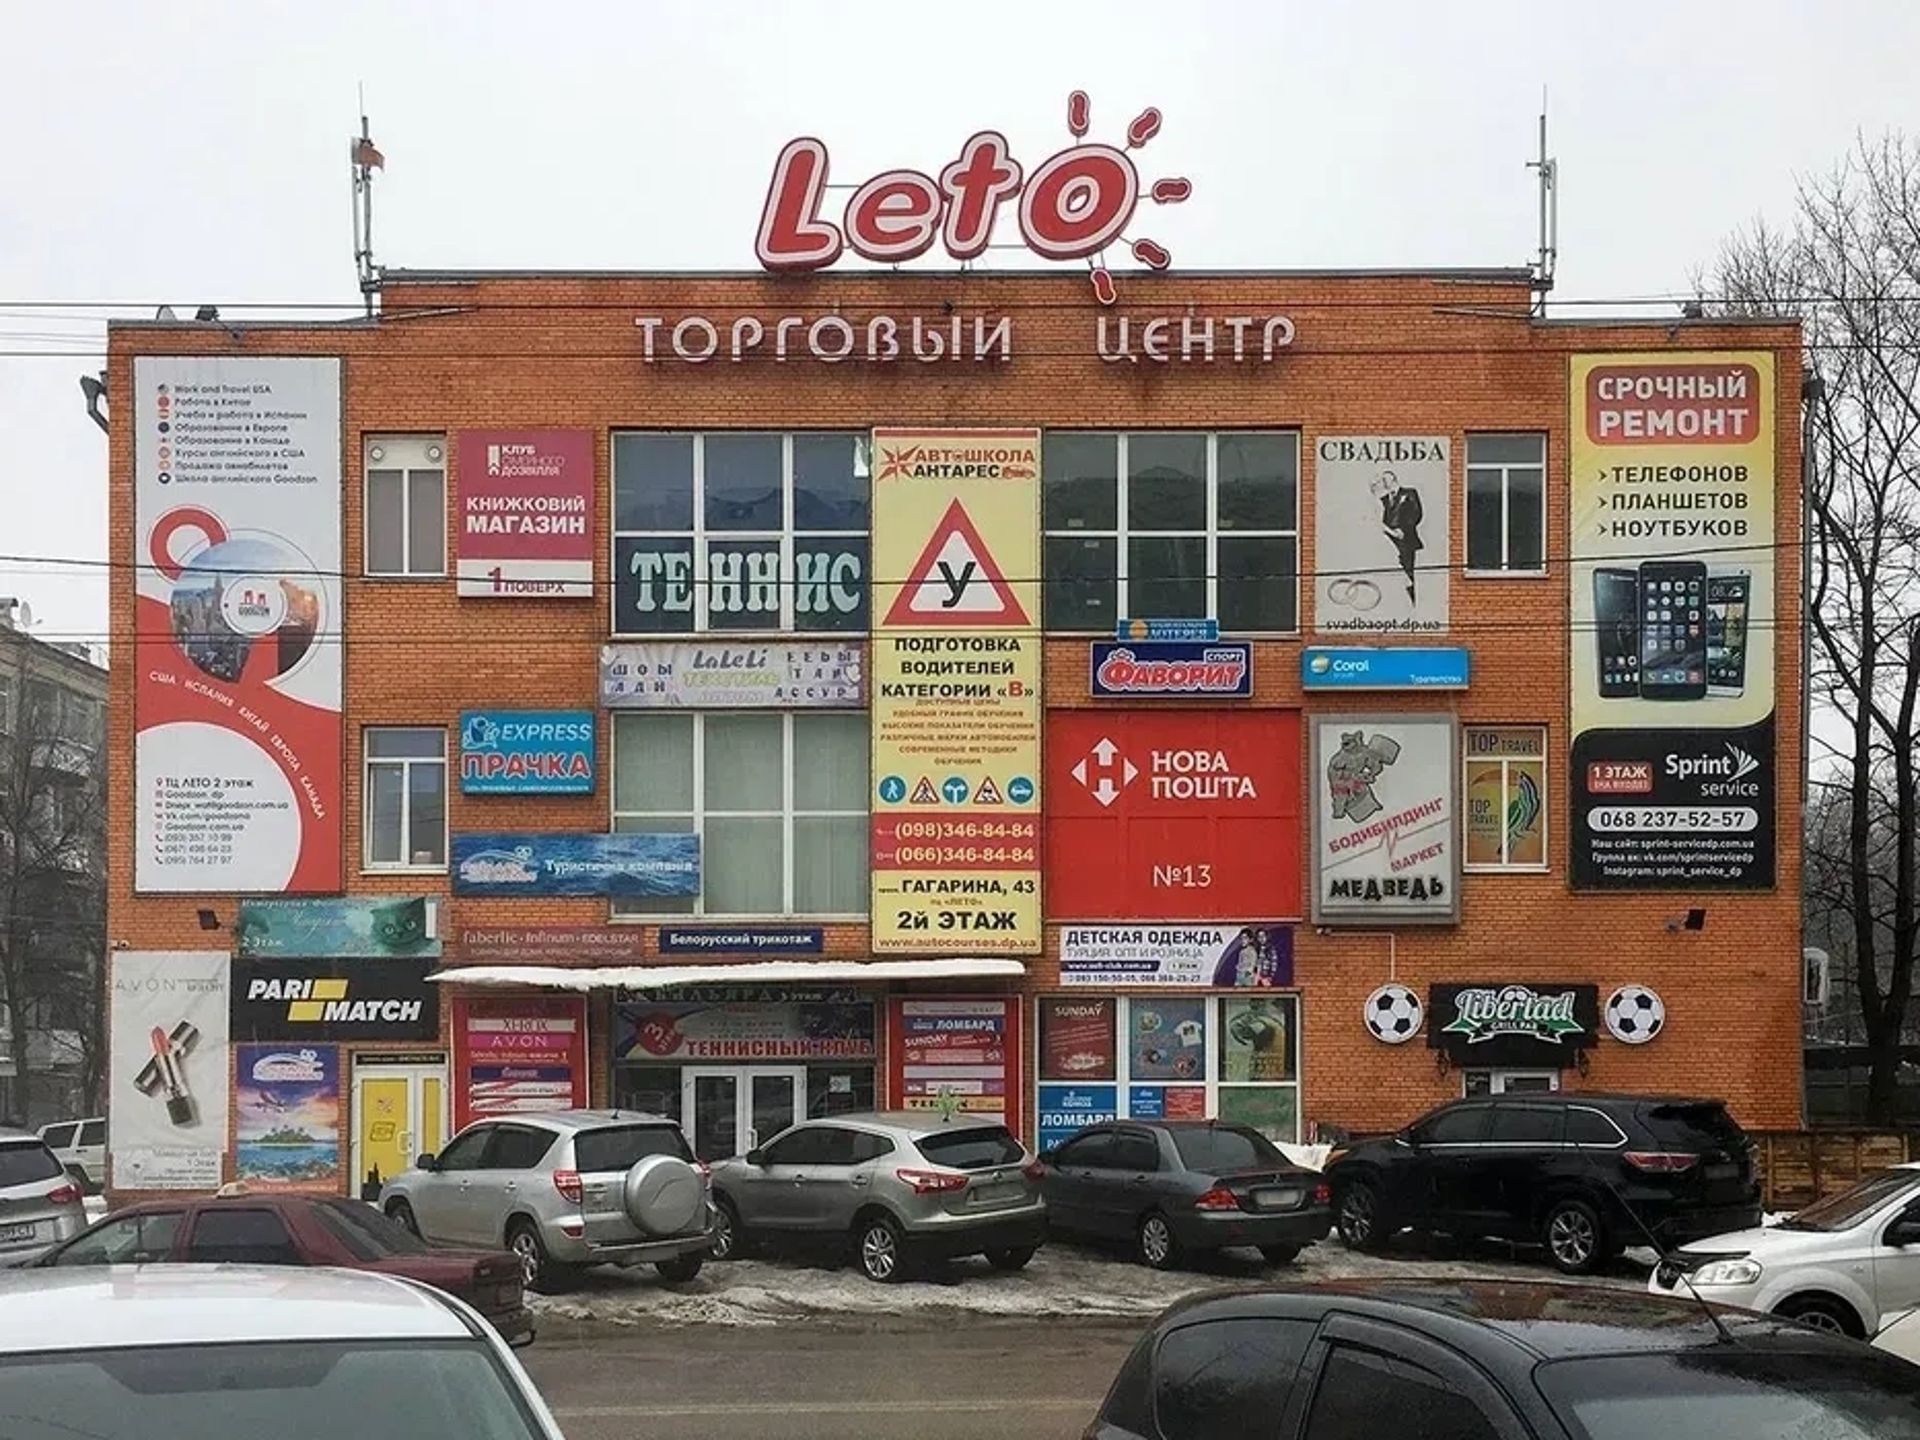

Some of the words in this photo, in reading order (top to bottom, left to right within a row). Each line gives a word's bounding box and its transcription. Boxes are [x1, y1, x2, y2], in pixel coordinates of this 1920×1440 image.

[755, 130, 1139, 273] Leto
[1098, 316, 1296, 364] ЦЕНТР
[1598, 370, 1747, 400] СРОЧНЫЙ
[1599, 408, 1749, 437] РЕМОНТ
[501, 444, 536, 455] КЛУБ
[915, 449, 1035, 462] АВТОШКОЛА
[1320, 441, 1445, 463] СВАДЬБА
[914, 465, 1000, 478] АНТАРЕС
[1611, 466, 1748, 483] ТЕЛЕФОНОВ
[466, 495, 586, 511] КНИЖКОВИЙ
[1612, 493, 1748, 510] ПЛАНШЕТОВ
[466, 515, 586, 534] МАГАЗИН
[1612, 520, 1748, 537] НОУТБУКОВ
[488, 566, 502, 593] 1
[504, 581, 565, 593] ПОВЕРХ
[631, 552, 861, 612] ТЕННИС
[1326, 617, 1441, 633] svadbaopt.dp.ua
[895, 637, 1021, 653] ПОДГОТОВКА
[1206, 652, 1242, 662] СПОРТ
[1332, 659, 1369, 671] Coral
[901, 659, 1014, 676] ВОДИТЕЛЕЙ
[1100, 658, 1244, 690] ФАВОРИТ
[881, 684, 991, 697] КАТЕГОРИИ
[501, 723, 592, 741] EXPRESS
[1469, 733, 1498, 751] TOP
[461, 752, 592, 779] ПРАЧКА
[1151, 750, 1229, 772] НОВА
[1665, 753, 1731, 780] Sprint
[1593, 766, 1599, 778] 1
[1605, 766, 1647, 778] ЭТАЖ
[165, 778, 180, 789] ТЦ
[182, 778, 211, 788] ЛЕТО
[214, 778, 221, 787] 2
[1151, 776, 1257, 798] ПОШТА
[1701, 780, 1759, 796] service
[1329, 798, 1443, 854] БОДИБИЛДИНГ
[1600, 811, 1636, 827] 068
[1643, 811, 1746, 827] 237-52-57
[895, 823, 1035, 839] (098)346-84-84
[1591, 839, 1613, 848] Наш
[895, 847, 1035, 864] (066)346-84-84
[1391, 842, 1444, 872] МАРКЕТ
[1153, 864, 1212, 887] №13
[1657, 865, 1742, 878] sprint_service_dp
[902, 880, 1008, 896] ГАГАРИНА,
[1013, 880, 1035, 893] 43
[1329, 876, 1443, 902] МЕДВЕДЬ
[897, 911, 929, 930] 2й
[938, 912, 1017, 930] ЭТАЖ
[670, 934, 750, 947] Белорусский
[753, 935, 813, 946] трикотаж
[879, 938, 1037, 949] www.autocourses.dp.ua
[1066, 930, 1143, 946] ДЕТСКАЯ
[1148, 930, 1224, 946] ОДЕЖДА
[249, 979, 313, 999] PARI
[324, 1001, 421, 1021] MATCH
[1055, 1004, 1103, 1016] SUNDAY
[1455, 987, 1576, 1027] Libertad
[936, 1019, 995, 1031] ЛОМБАРД
[491, 1035, 548, 1047] AVON
[686, 1040, 812, 1056] ТЕННИСНЫЙ
